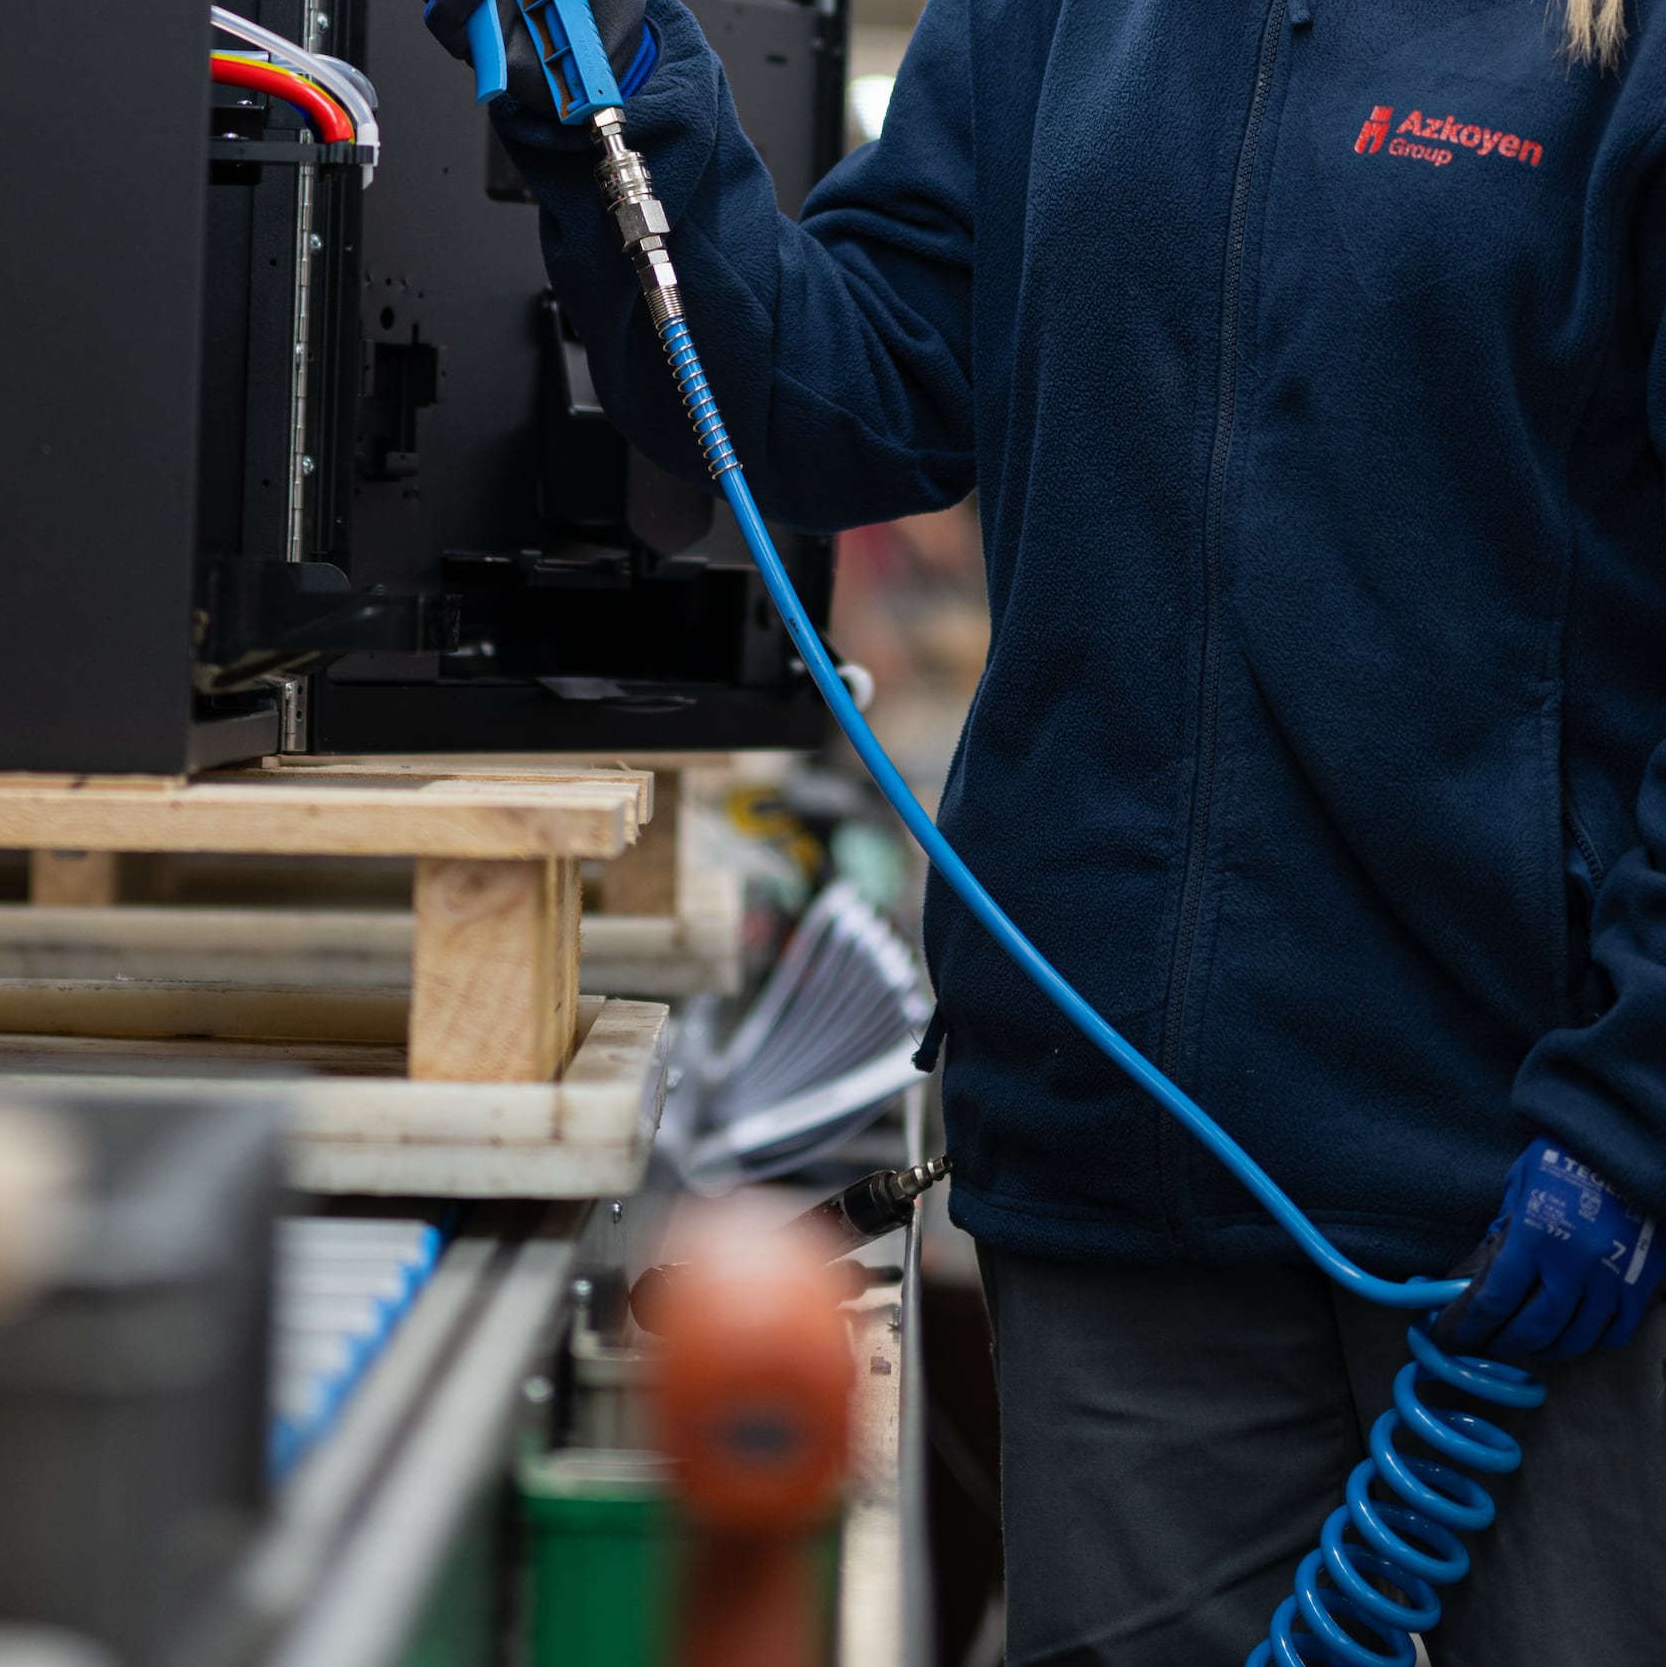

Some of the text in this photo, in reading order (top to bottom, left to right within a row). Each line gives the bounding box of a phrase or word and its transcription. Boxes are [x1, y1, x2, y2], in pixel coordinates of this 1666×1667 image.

[1388, 137, 1453, 167] Group
[1396, 110, 1544, 167] Azkoyen
[1611, 1238, 1627, 1261] 7
